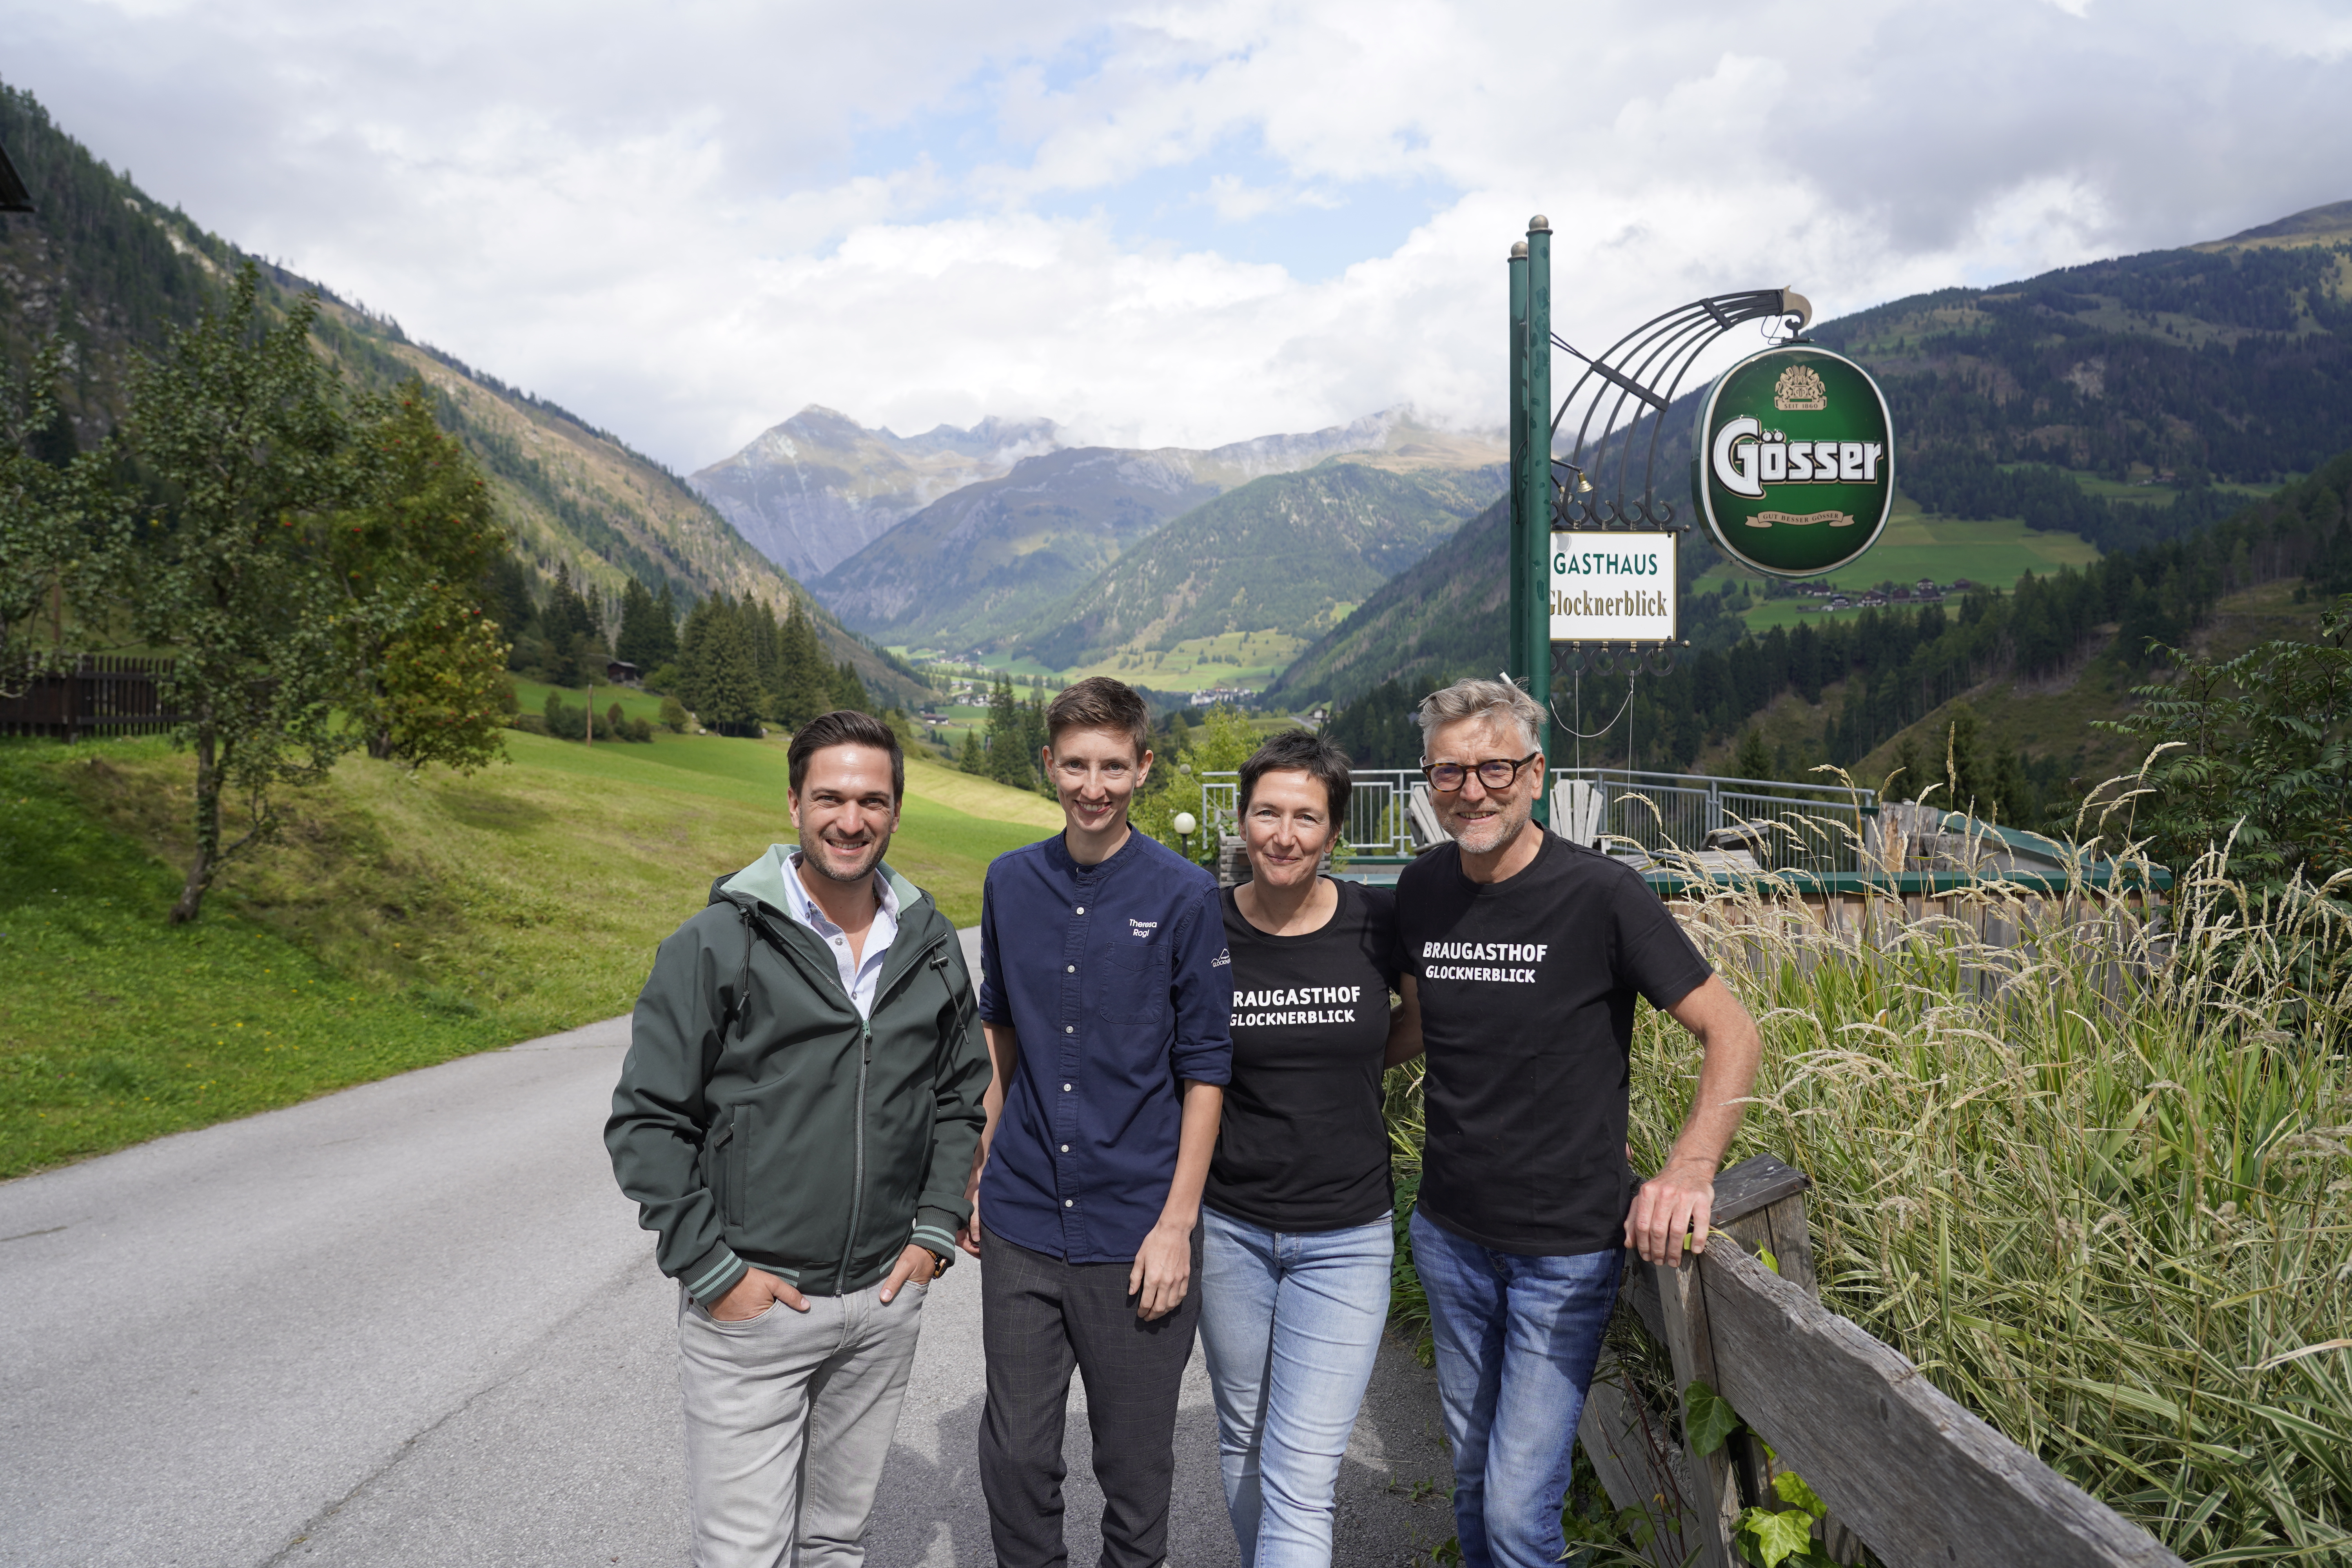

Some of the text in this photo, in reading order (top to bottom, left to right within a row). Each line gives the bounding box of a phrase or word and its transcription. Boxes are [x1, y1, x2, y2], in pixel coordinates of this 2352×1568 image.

[1713, 417, 1882, 498] Gösser
[1812, 513, 1838, 521] GÖSSER
[1553, 553, 1657, 575] GASTHAUS
[1129, 918, 1157, 928] Theresa
[1133, 929, 1150, 938] Rogl
[1423, 942, 1548, 962] BRAUGASTHOF
[1425, 965, 1536, 984] GLOCKNERBLICK
[1233, 986, 1360, 1007] RAUGASTHOF
[1230, 1009, 1356, 1026] GLOCKNERBLICK
